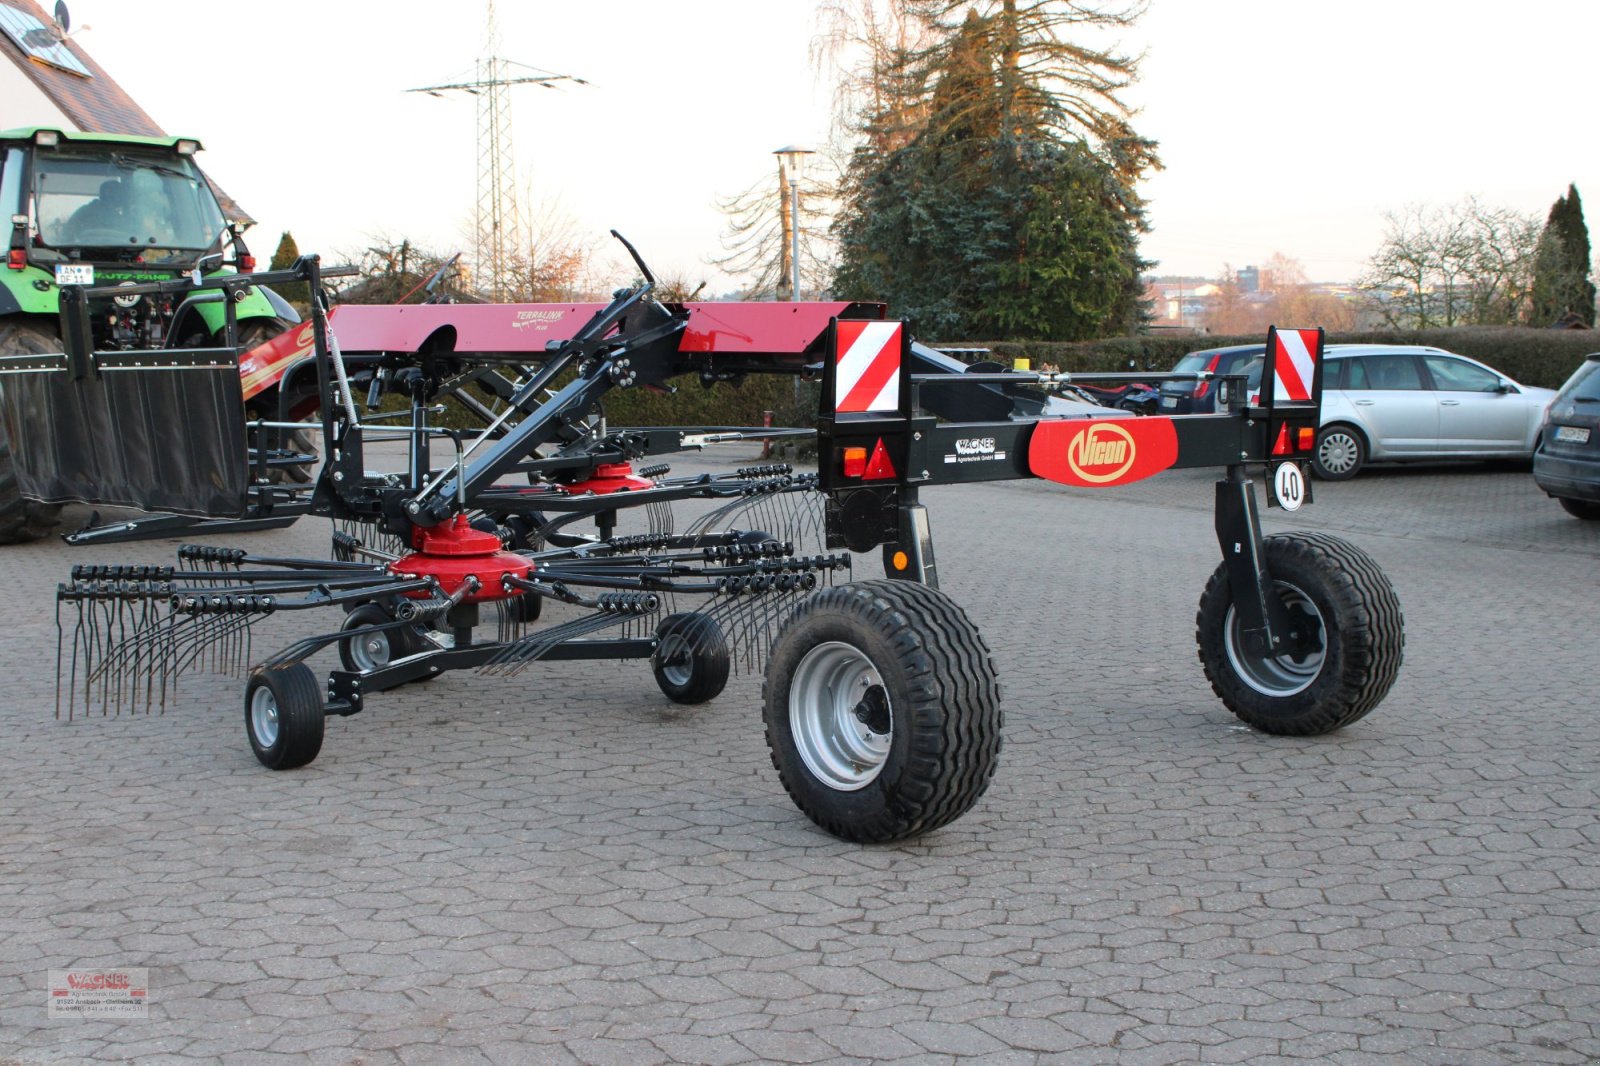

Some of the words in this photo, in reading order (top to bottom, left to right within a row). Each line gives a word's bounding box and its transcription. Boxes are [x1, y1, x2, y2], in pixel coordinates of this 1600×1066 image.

[64, 266, 76, 274] AN
[60, 275, 71, 283] DF
[74, 275, 85, 283] 11
[956, 438, 995, 453] WAGNER
[1077, 428, 1128, 467] Vicon
[1282, 471, 1299, 501] 40
